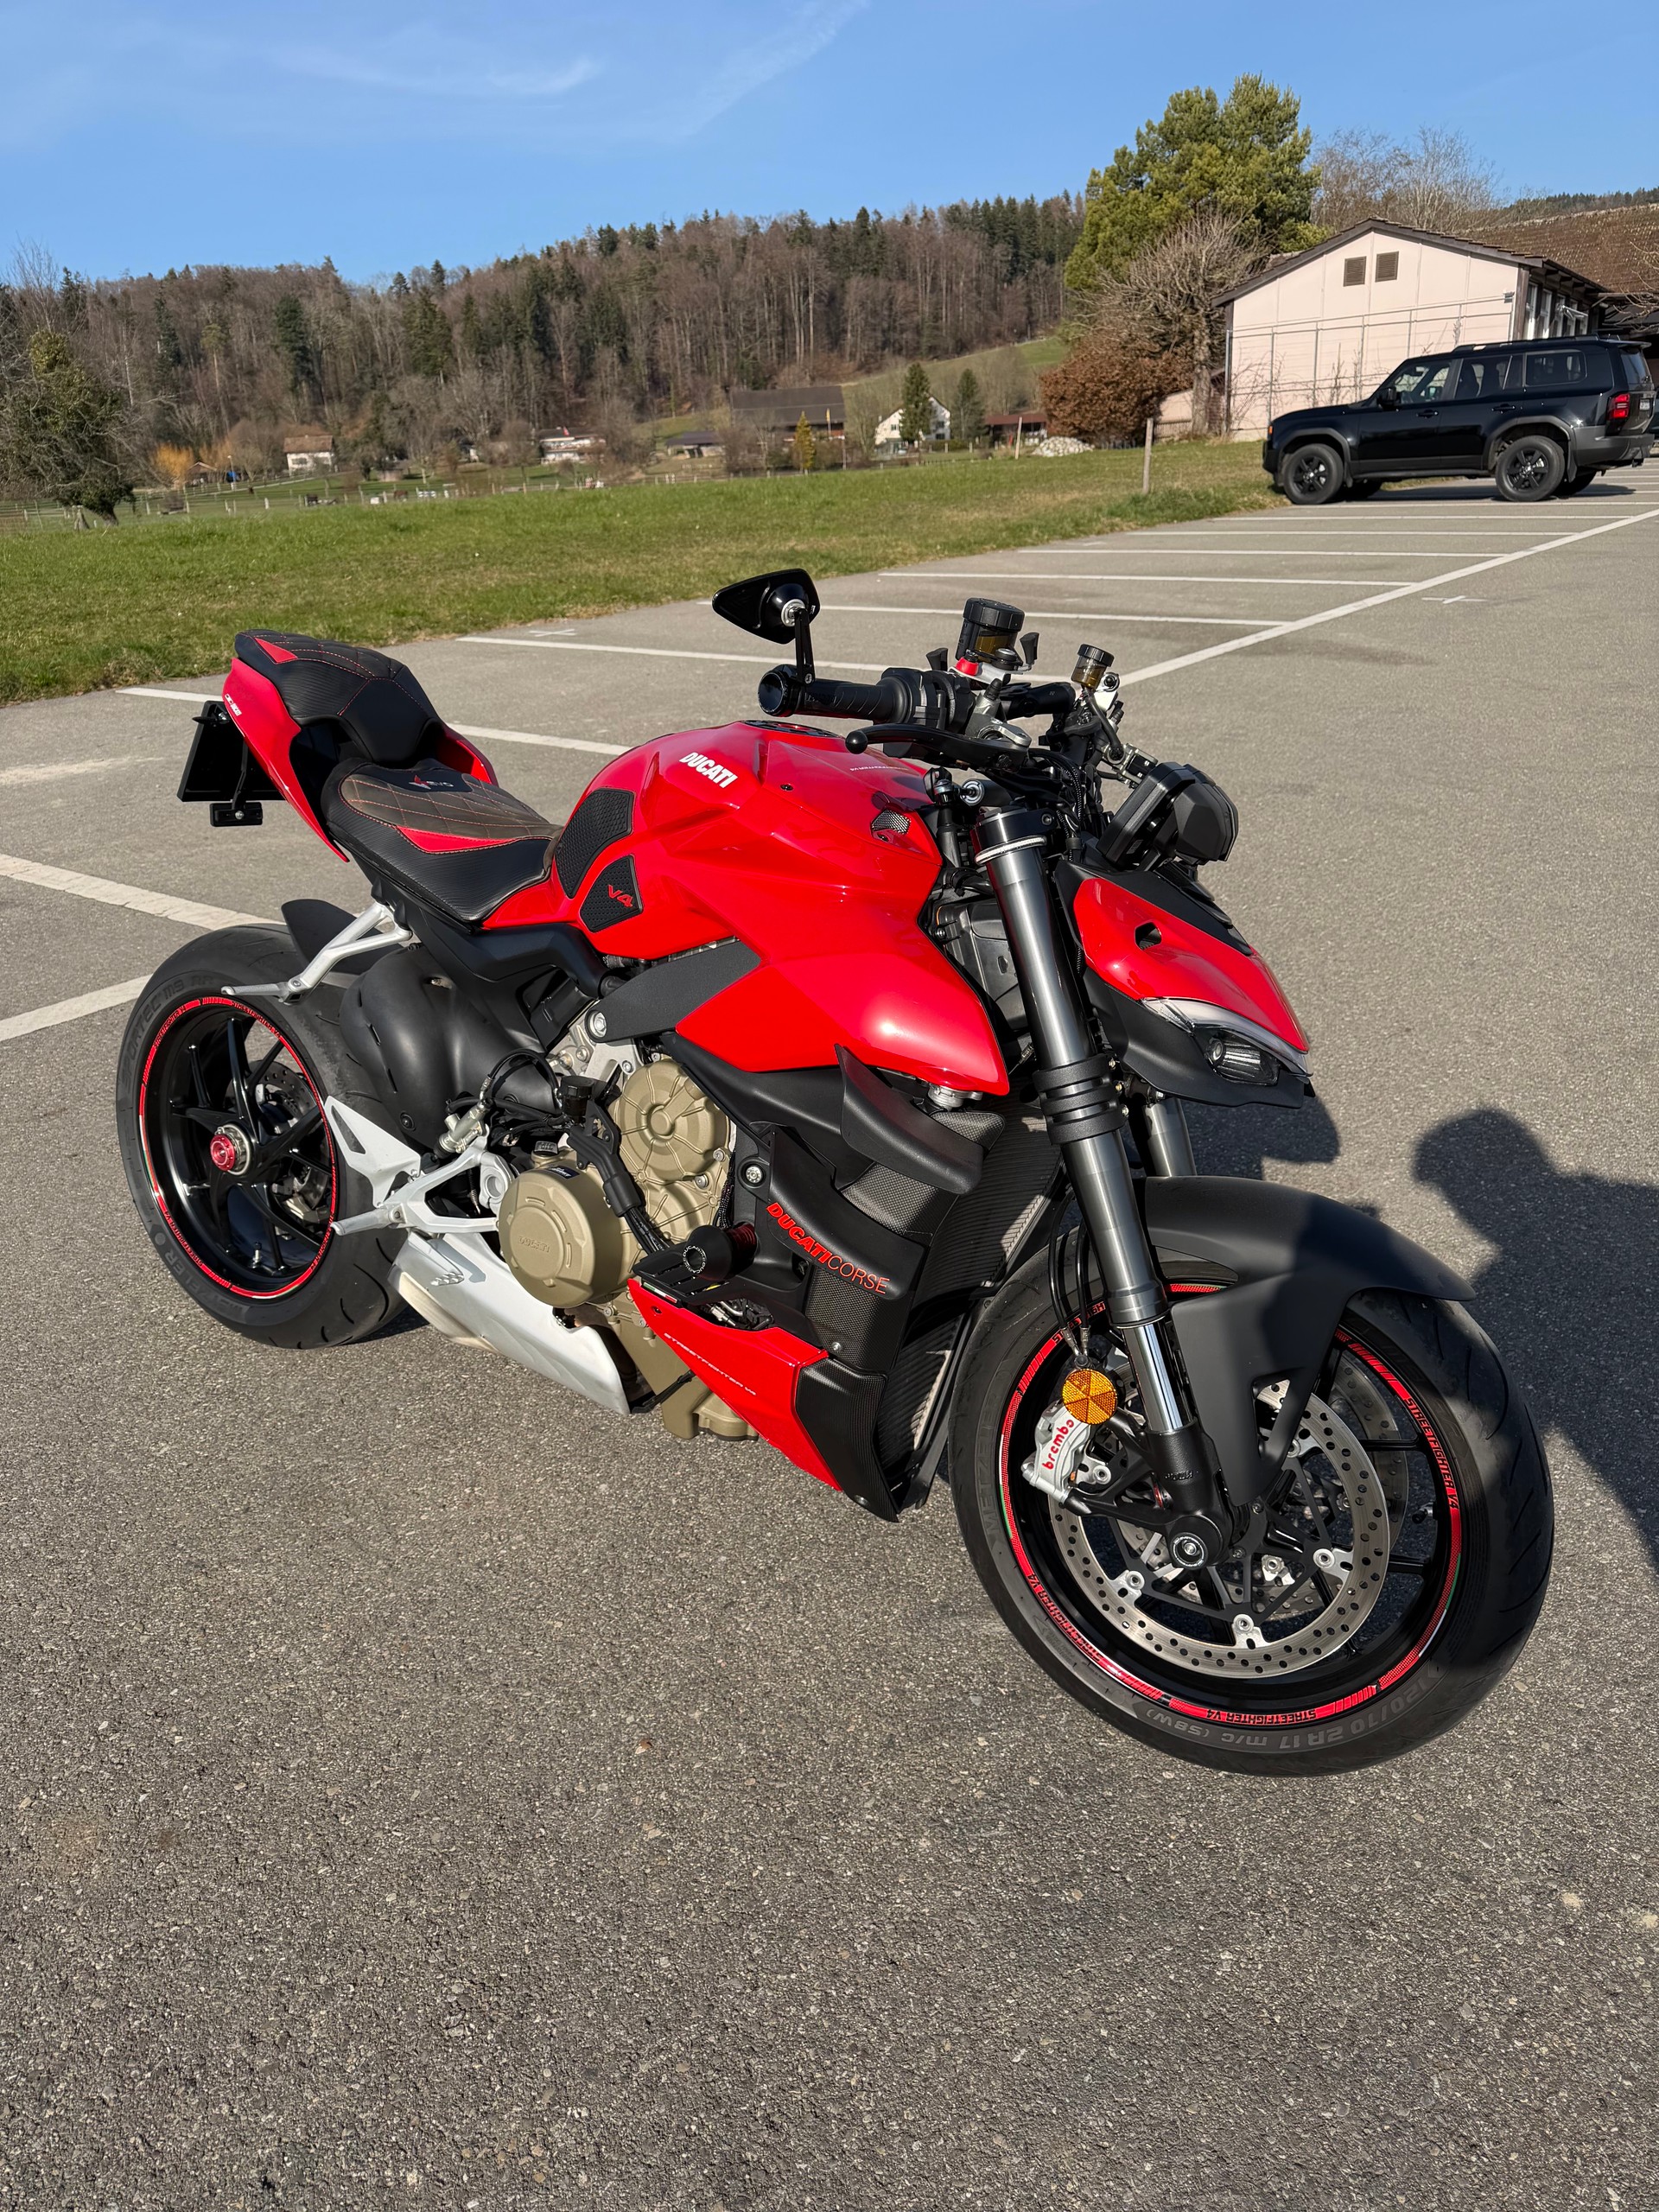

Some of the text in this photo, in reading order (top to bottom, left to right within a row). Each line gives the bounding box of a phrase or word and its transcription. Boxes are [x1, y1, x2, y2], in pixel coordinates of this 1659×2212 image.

[678, 752, 738, 789] DUCATI
[608, 884, 633, 907] V4
[1042, 1420, 1074, 1470] brembo
[1403, 1397, 1459, 1510] STREETFIGHTER V4
[1027, 1573, 1040, 1589] V4
[1037, 1590, 1103, 1662] STREETFIGHTER
[1146, 1708, 1210, 1738] (58W)
[1206, 1709, 1317, 1726] STREETFIGHTER V4
[1350, 1677, 1426, 1734] 120/70
